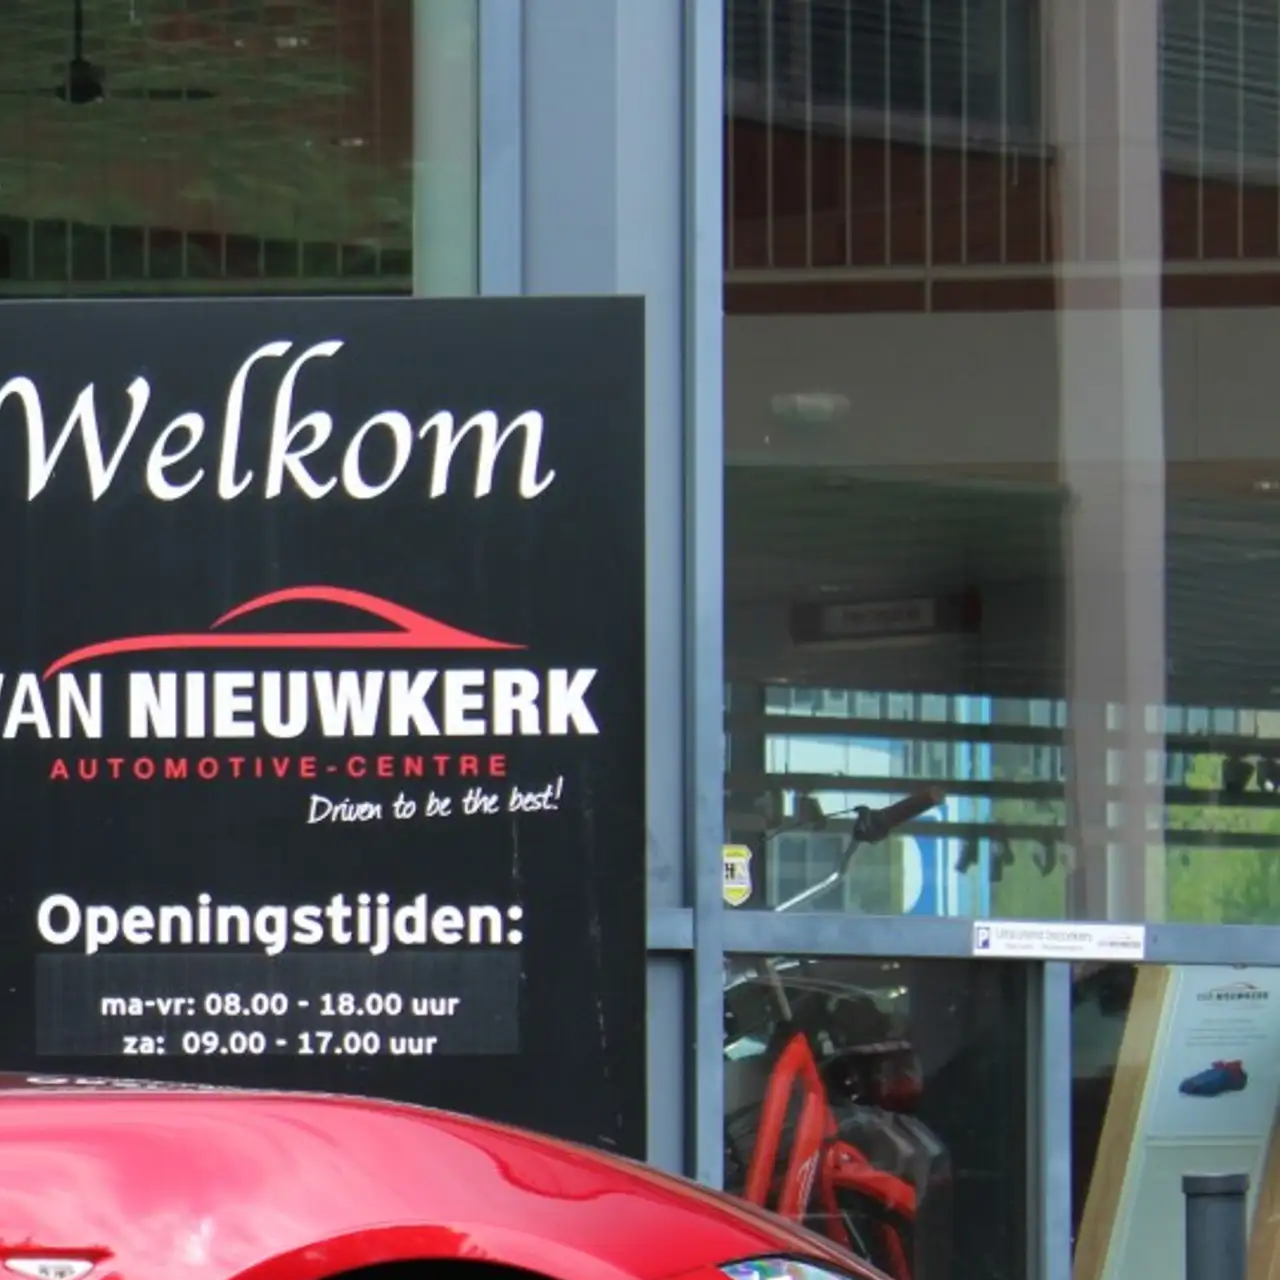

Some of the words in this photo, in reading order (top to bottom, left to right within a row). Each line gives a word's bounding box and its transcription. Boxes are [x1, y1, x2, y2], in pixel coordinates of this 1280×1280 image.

[128, 667, 600, 739] NIEUWKERK
[50, 753, 508, 781] AUTOMOTIVE-CENTRE
[307, 793, 383, 824] Driven
[391, 792, 417, 820] to
[425, 790, 452, 817] be
[461, 786, 500, 815] the
[508, 775, 565, 813] best!
[36, 892, 524, 957] Openingstijden:
[100, 996, 196, 1017] ma-vr:
[203, 991, 289, 1017] 08.00
[319, 991, 403, 1017] 18.00
[411, 997, 461, 1017] uur
[122, 1035, 166, 1056] za:
[181, 1030, 267, 1055] 09.00
[297, 1030, 381, 1056] 17.00
[388, 1035, 438, 1056] uur
